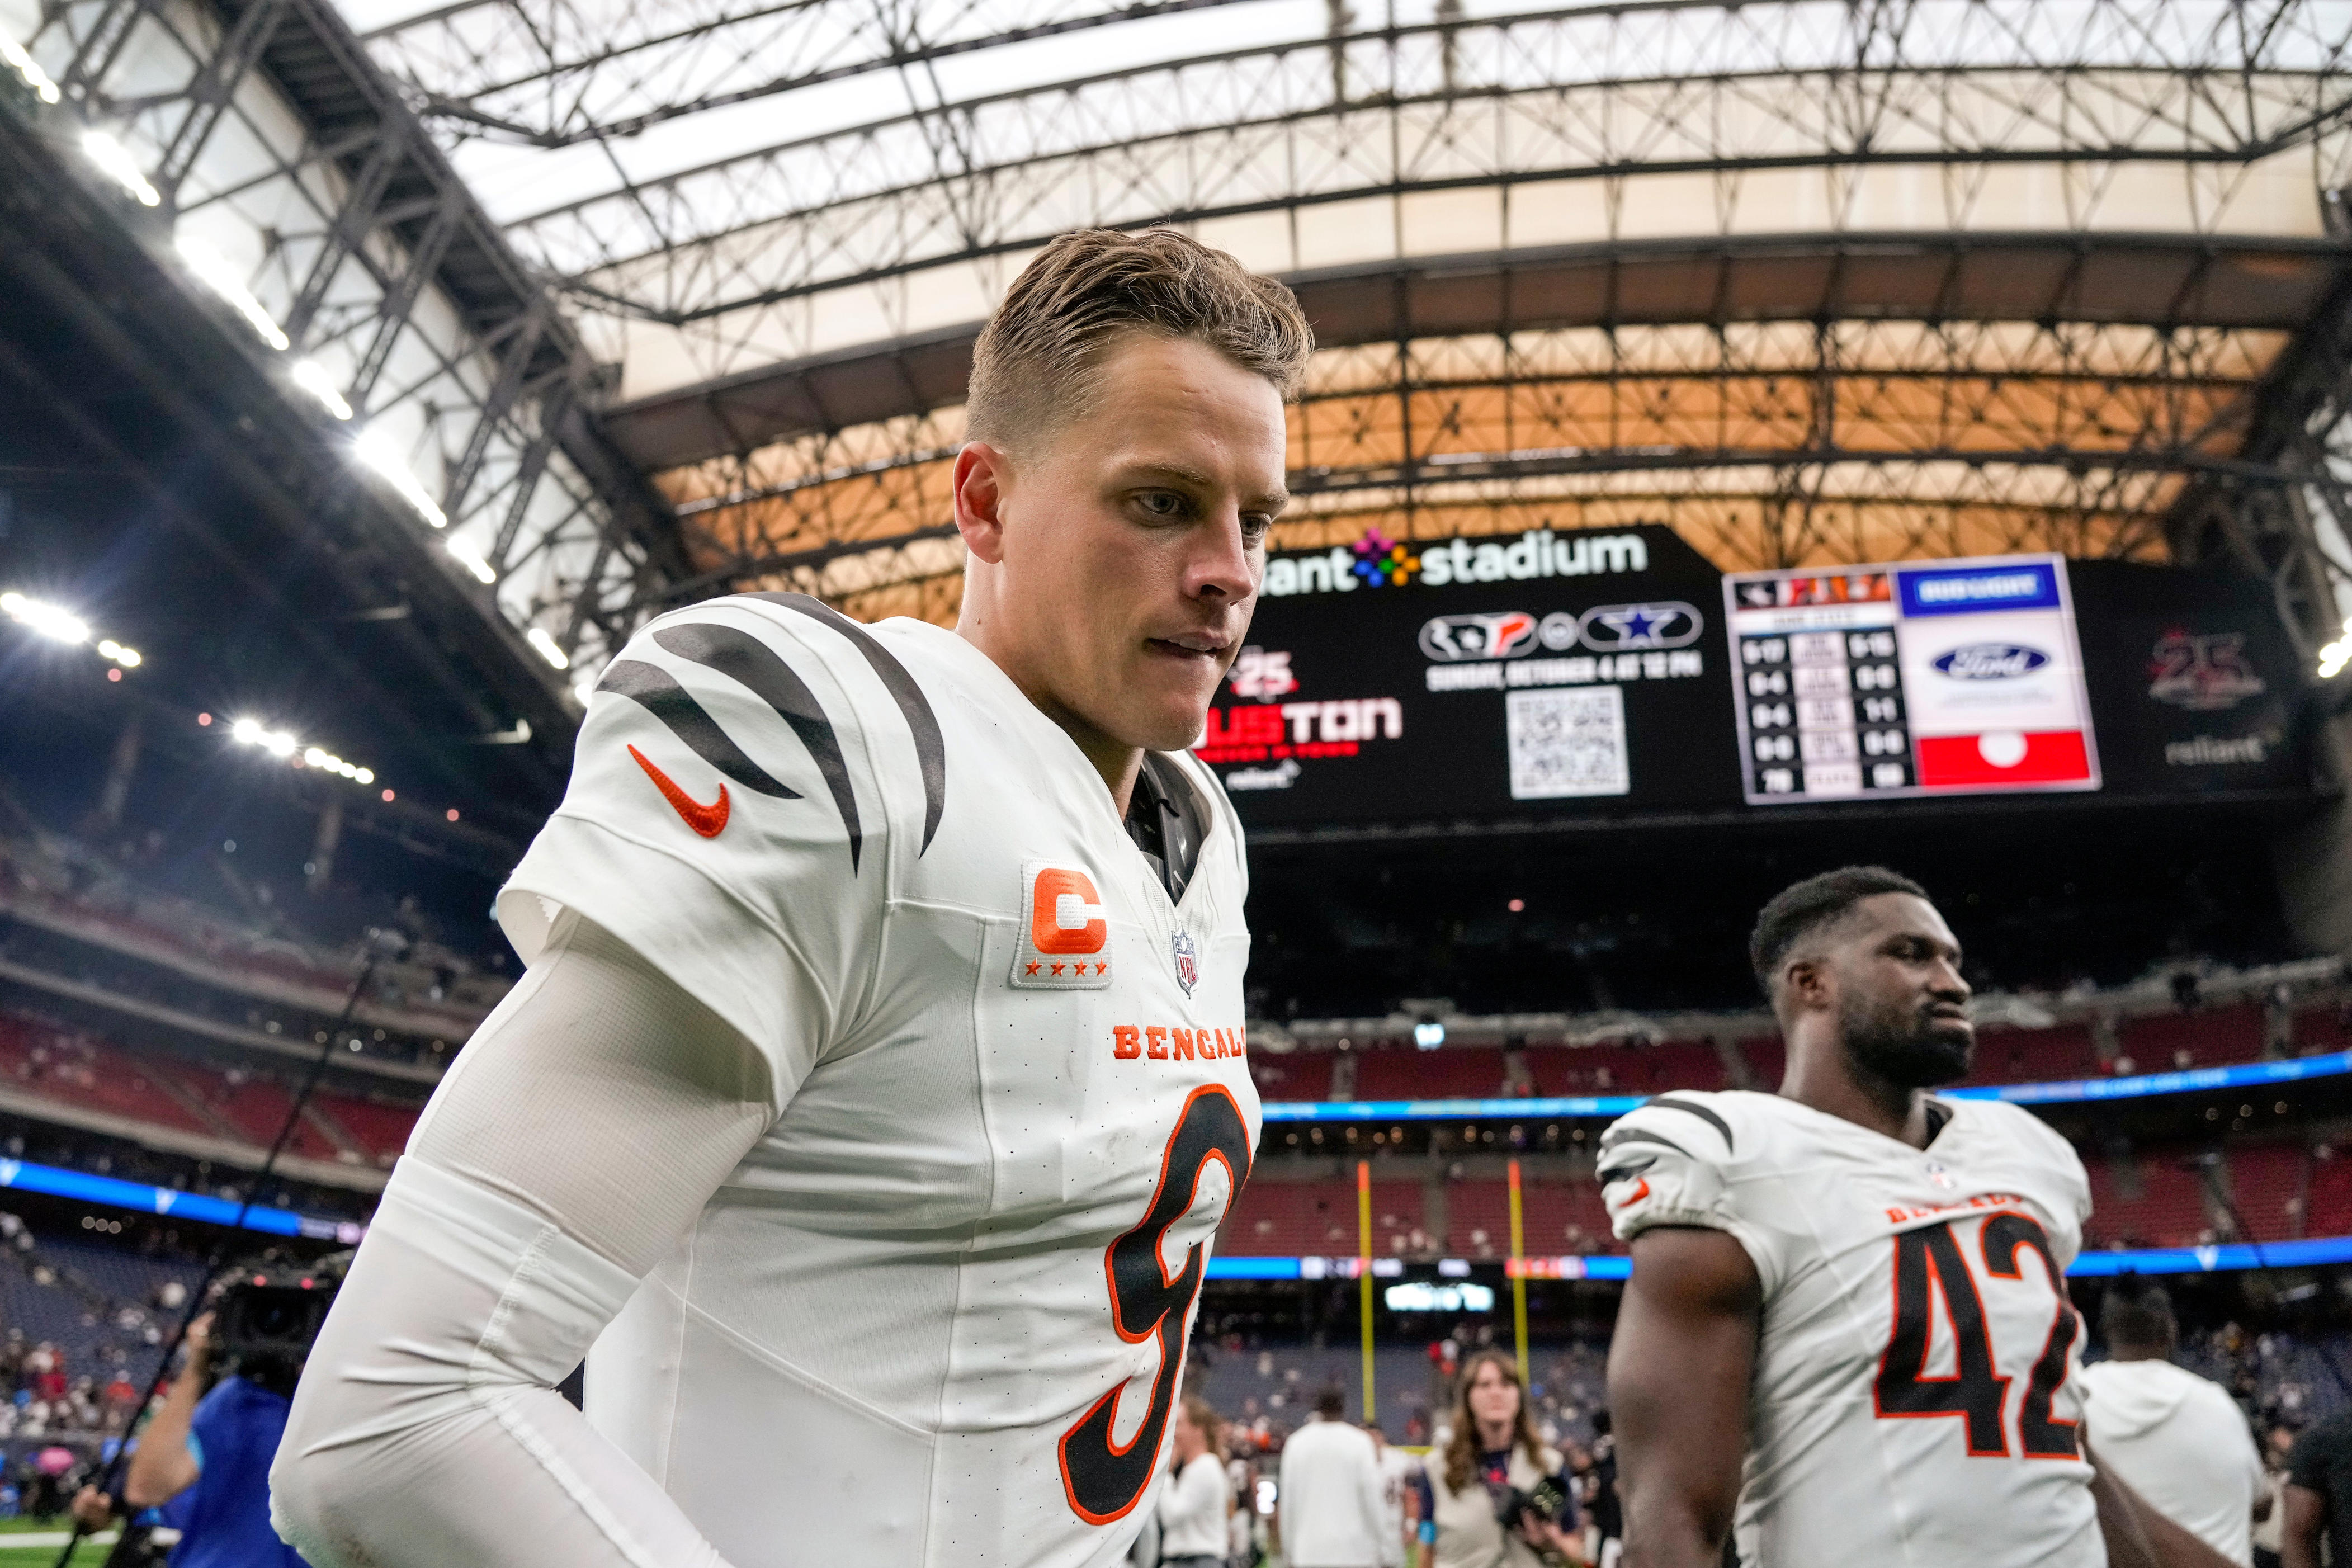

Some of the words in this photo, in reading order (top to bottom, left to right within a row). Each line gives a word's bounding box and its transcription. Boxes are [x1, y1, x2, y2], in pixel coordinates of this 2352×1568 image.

[1419, 529, 1648, 586] stadium
[1238, 651, 1293, 697] 25
[1948, 645, 2032, 678] Ford
[1031, 868, 1107, 954] C
[1179, 956, 1197, 984] NFL
[1058, 1083, 1252, 1526] 9
[1872, 1210, 2080, 1460] 42
